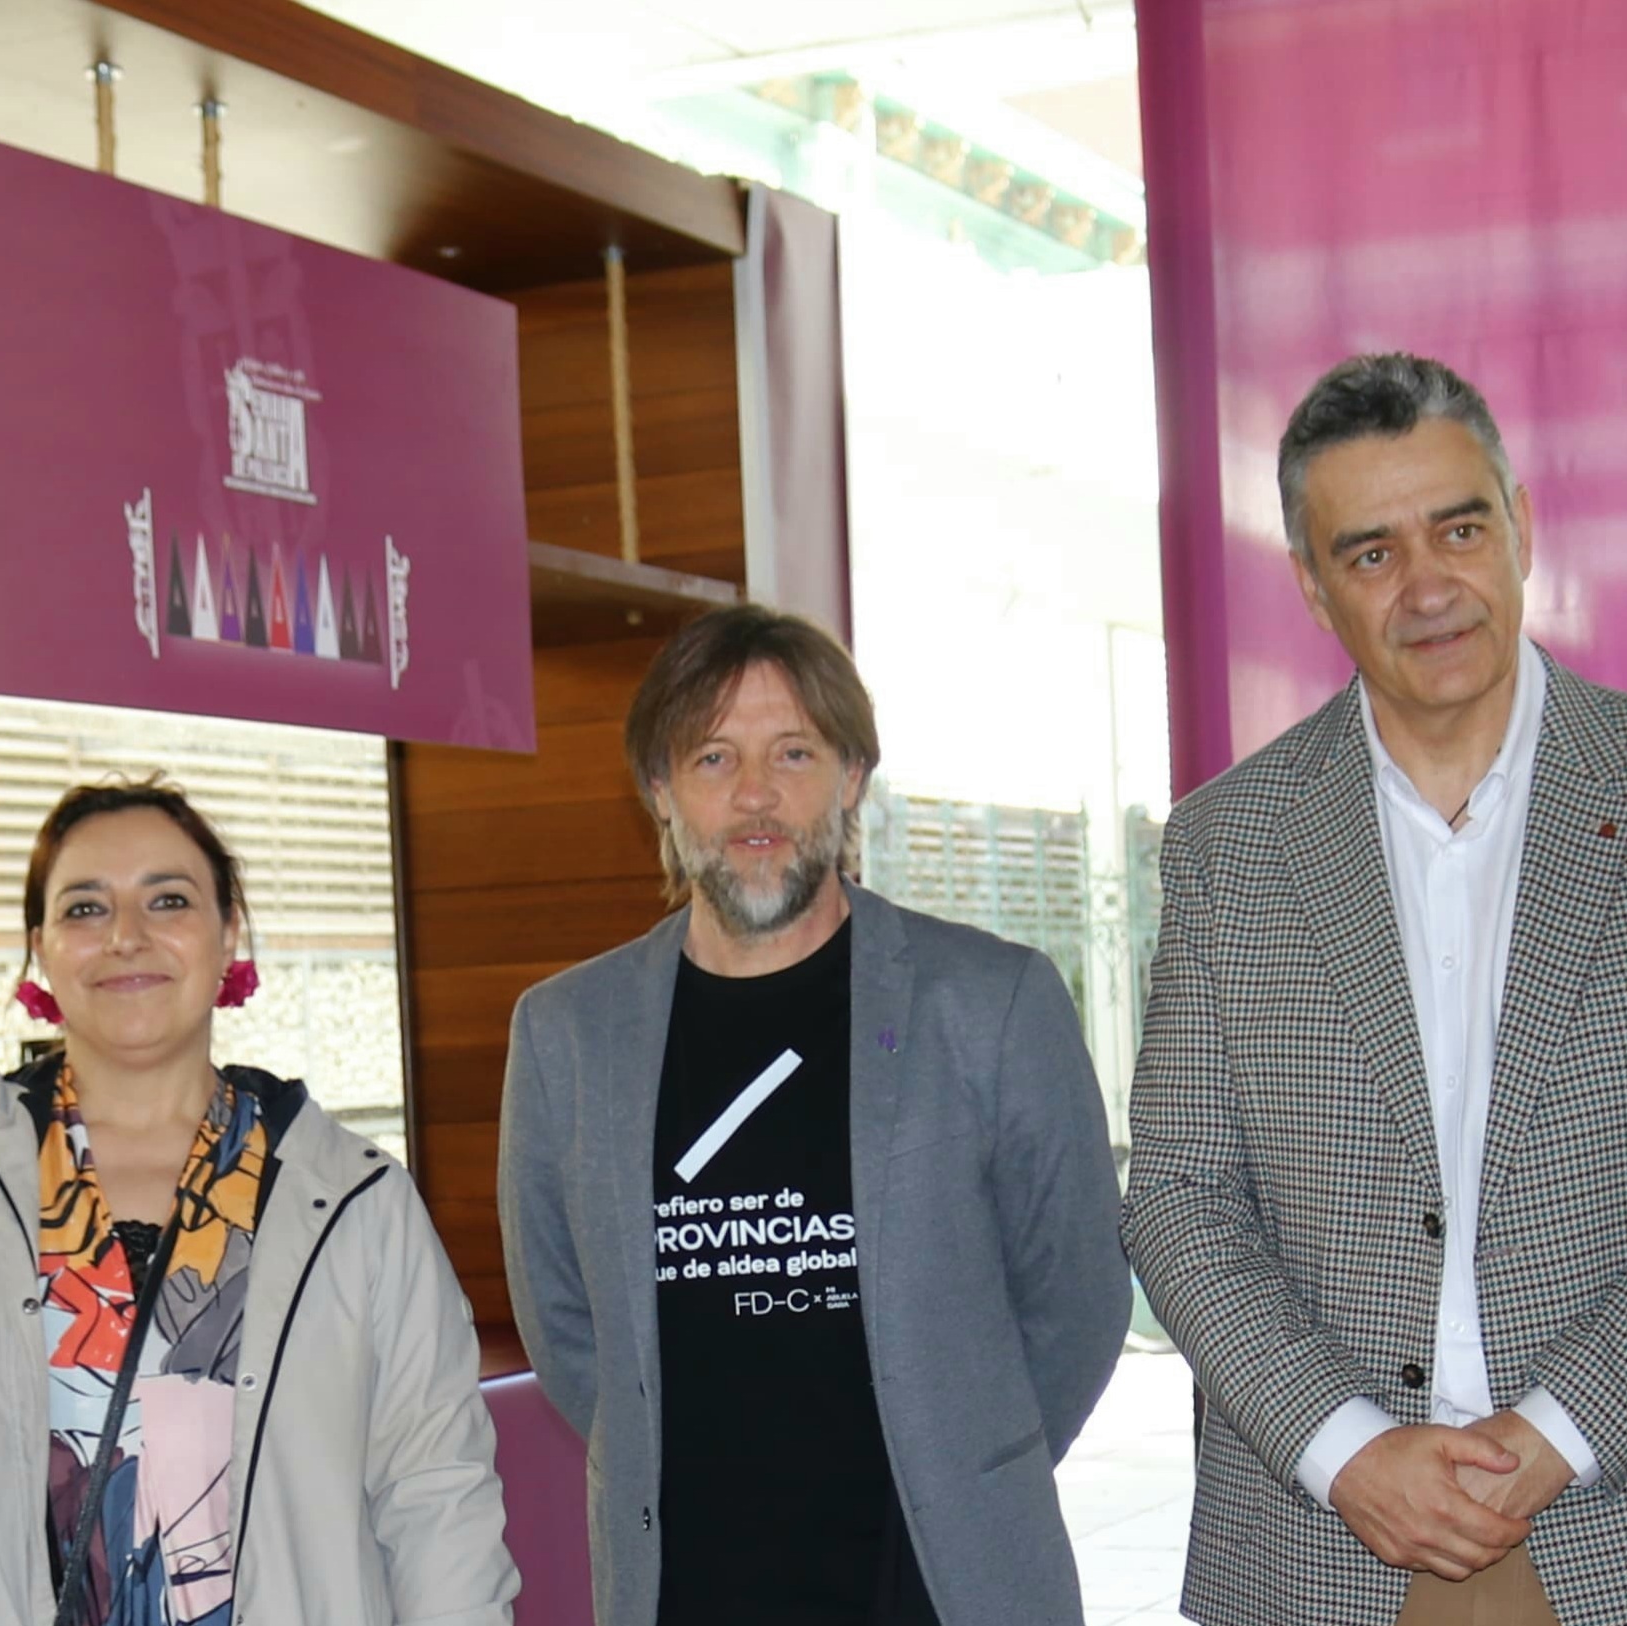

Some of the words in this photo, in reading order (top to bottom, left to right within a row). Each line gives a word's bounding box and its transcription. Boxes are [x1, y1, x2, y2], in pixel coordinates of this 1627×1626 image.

[729, 1194, 769, 1211] ser
[774, 1187, 804, 1208] de
[654, 1213, 856, 1254] ROVINCIAS
[655, 1266, 677, 1282] ue
[682, 1258, 712, 1279] de
[717, 1254, 781, 1277] aldea
[786, 1247, 858, 1277] global
[734, 1288, 810, 1316] FD-C
